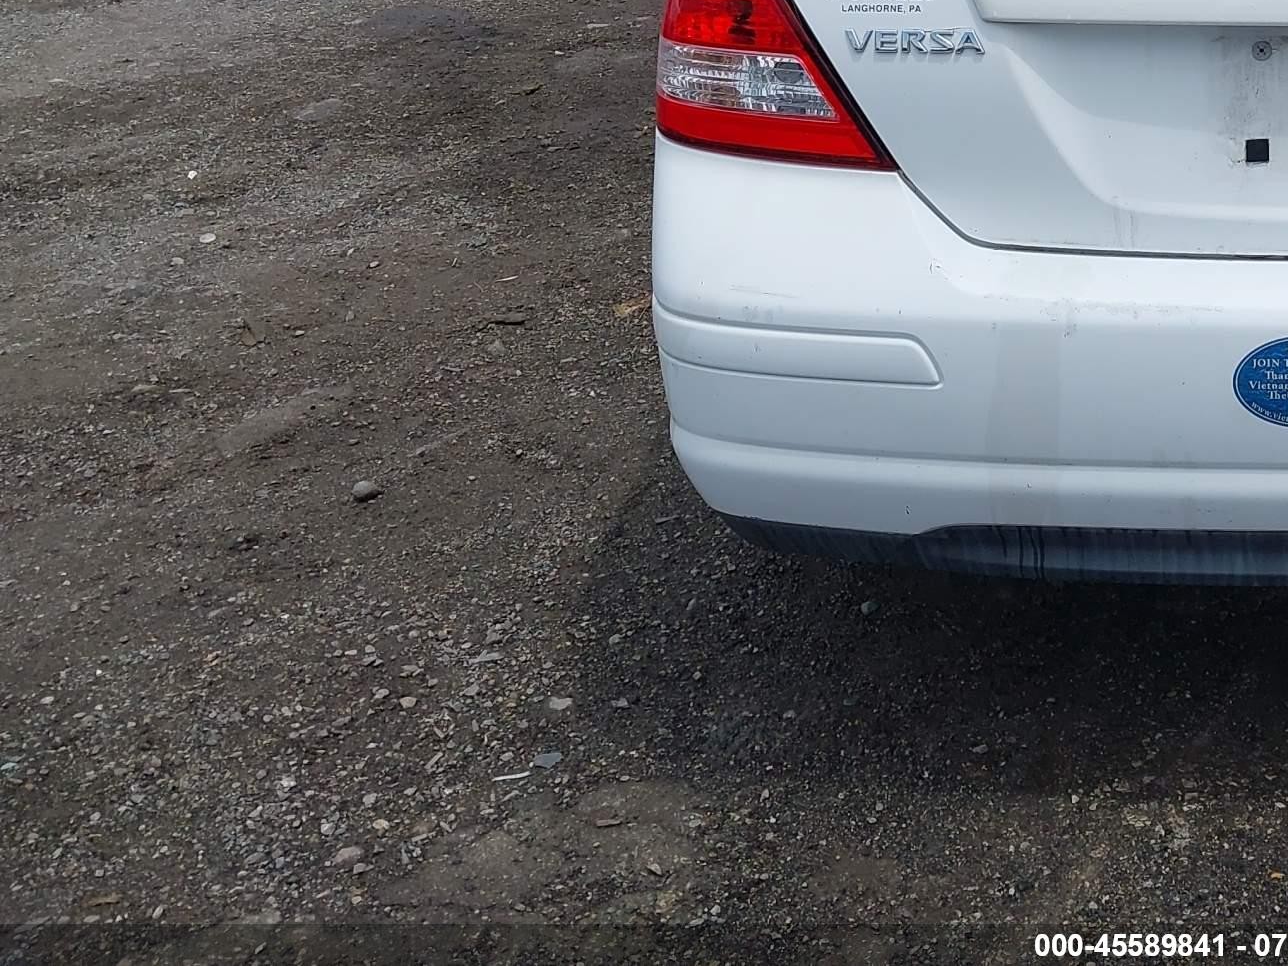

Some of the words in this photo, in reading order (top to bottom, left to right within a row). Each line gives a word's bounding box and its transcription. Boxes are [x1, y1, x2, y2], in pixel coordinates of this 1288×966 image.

[841, 4, 906, 14] LANGHORNE,
[909, 4, 922, 13] PA
[844, 27, 986, 55] VERSA
[1253, 358, 1280, 368] JOIN
